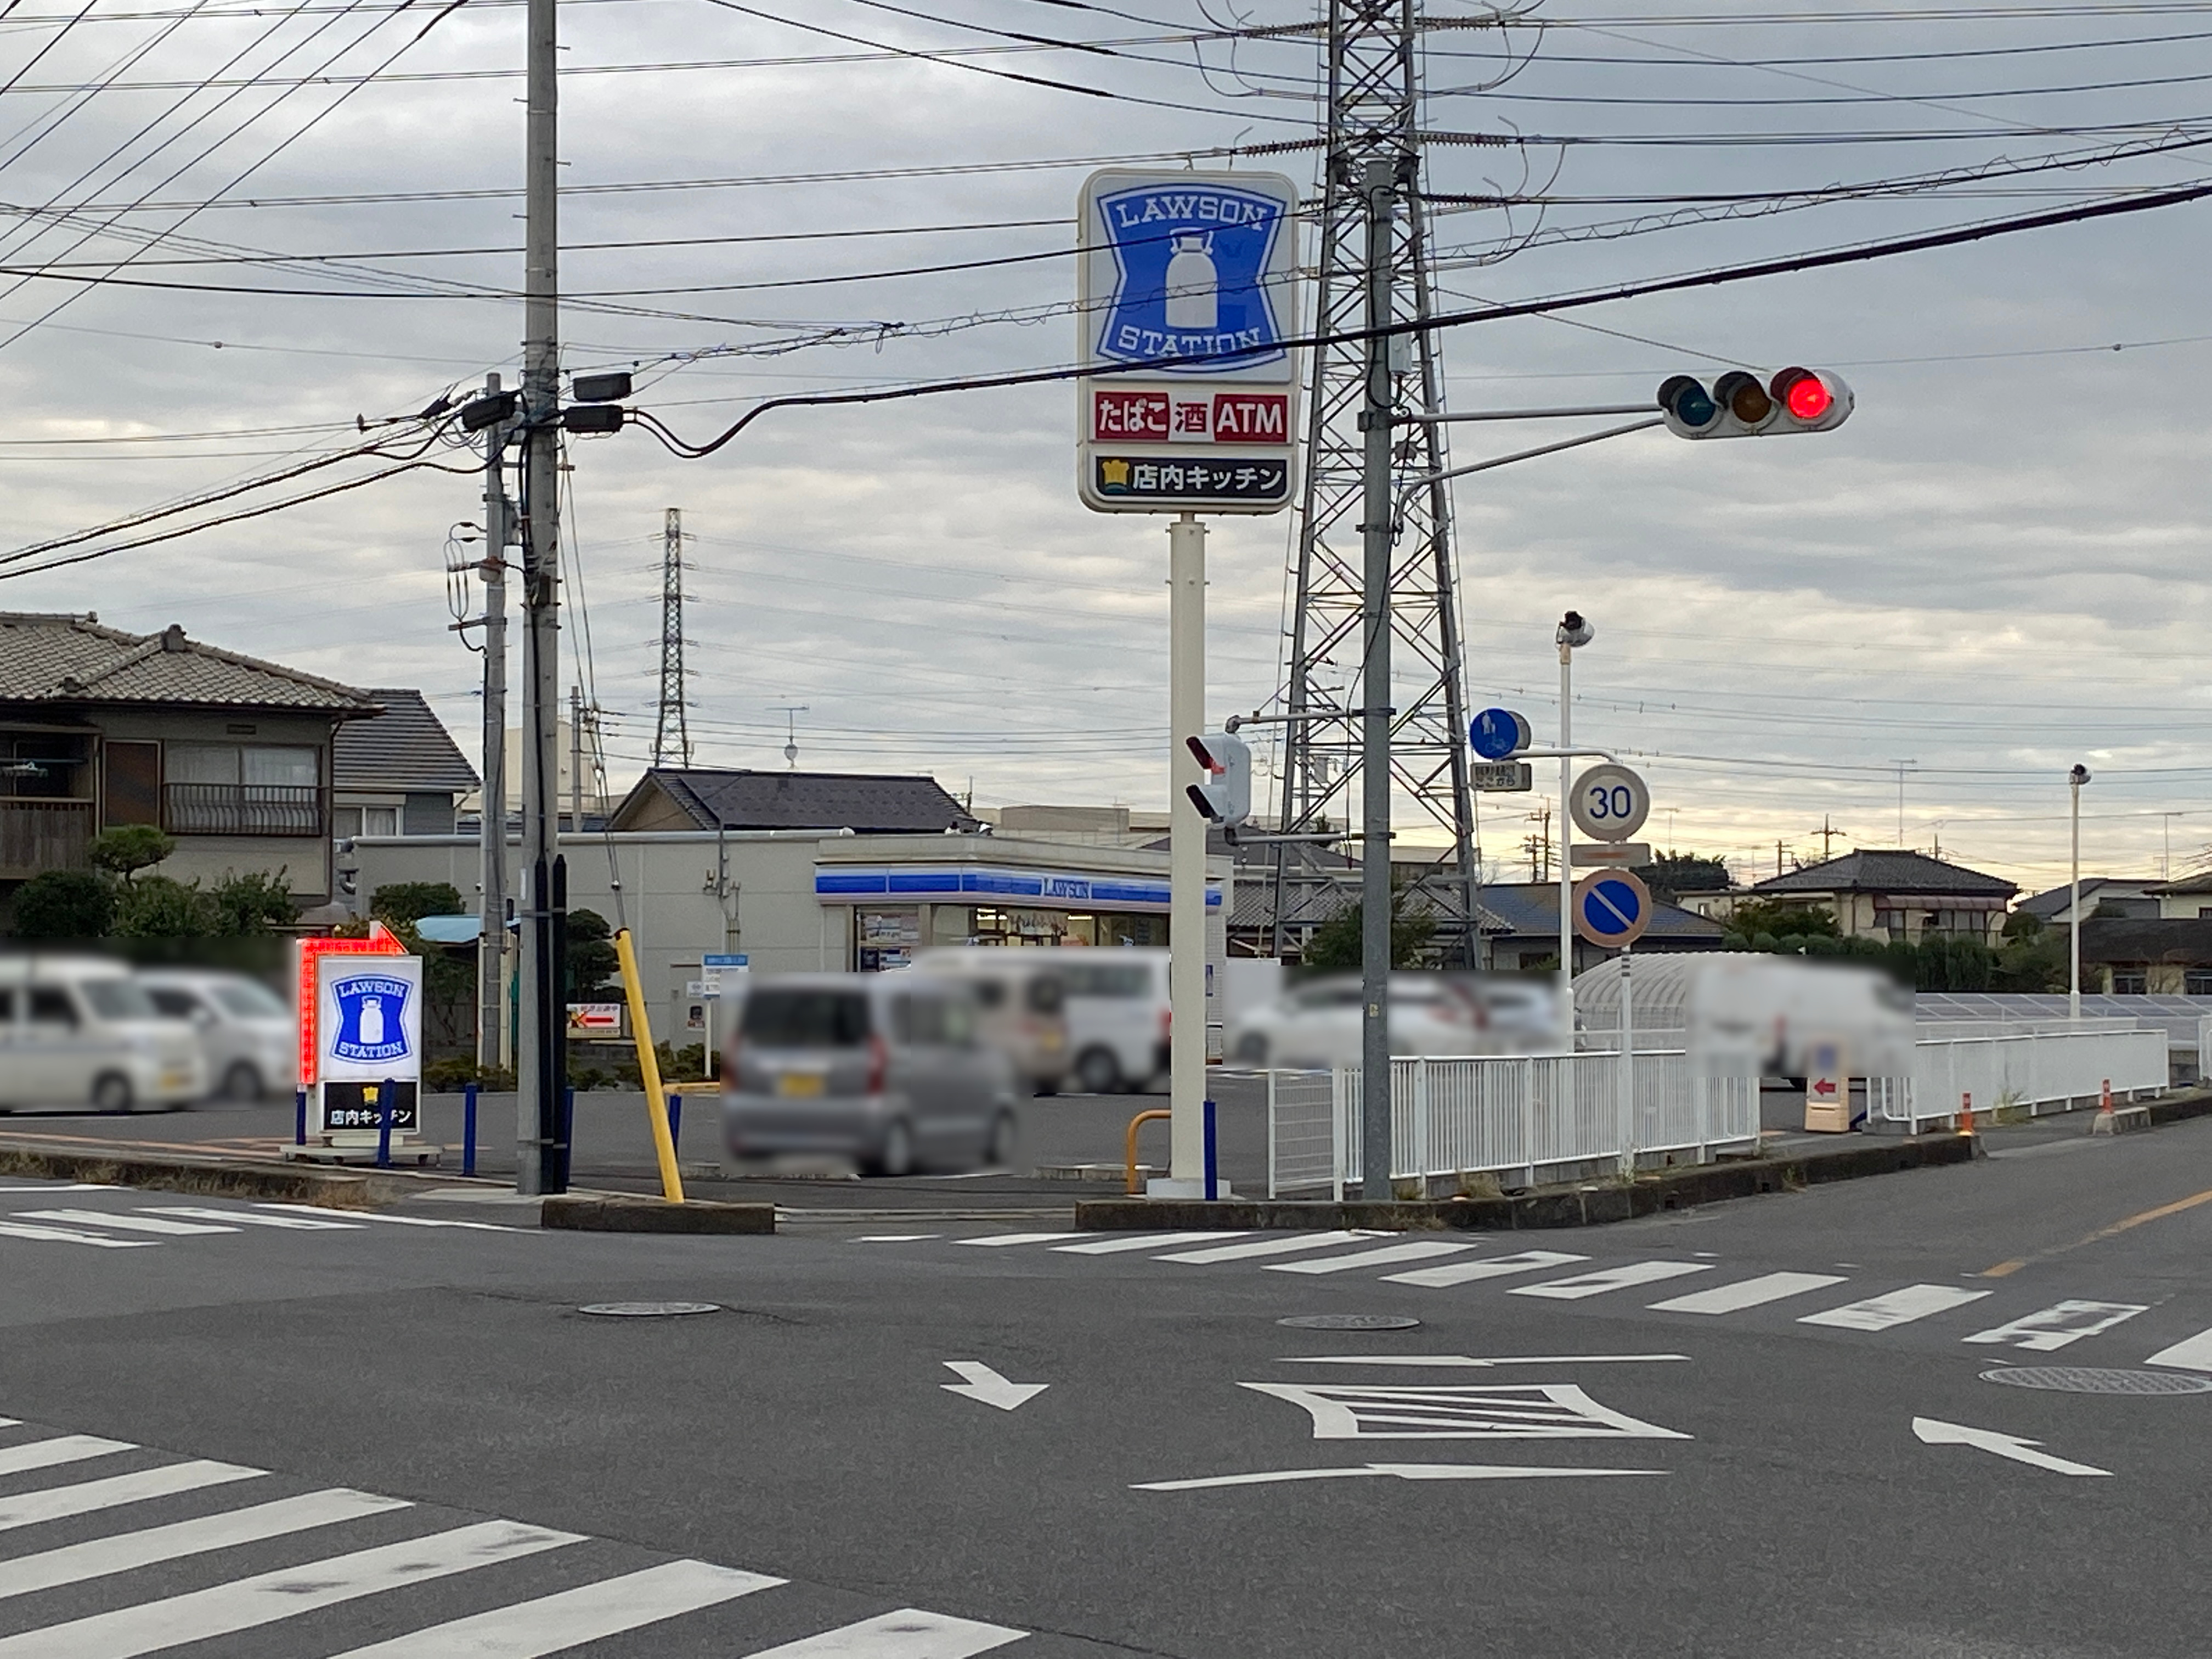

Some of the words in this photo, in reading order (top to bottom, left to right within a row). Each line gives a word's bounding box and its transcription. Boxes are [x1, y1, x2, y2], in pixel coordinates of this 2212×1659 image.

[1116, 195, 1267, 231] LAWSON
[1118, 324, 1261, 357] STATION
[1099, 397, 1167, 432] たばこ
[1175, 402, 1208, 432] 酒
[1216, 403, 1283, 434] ATM
[1132, 464, 1283, 491] 店内キッチン
[1589, 786, 1631, 819] 30
[1046, 878, 1090, 898] LAWSON
[338, 981, 405, 998] LAWSON
[338, 1041, 403, 1058] STATION
